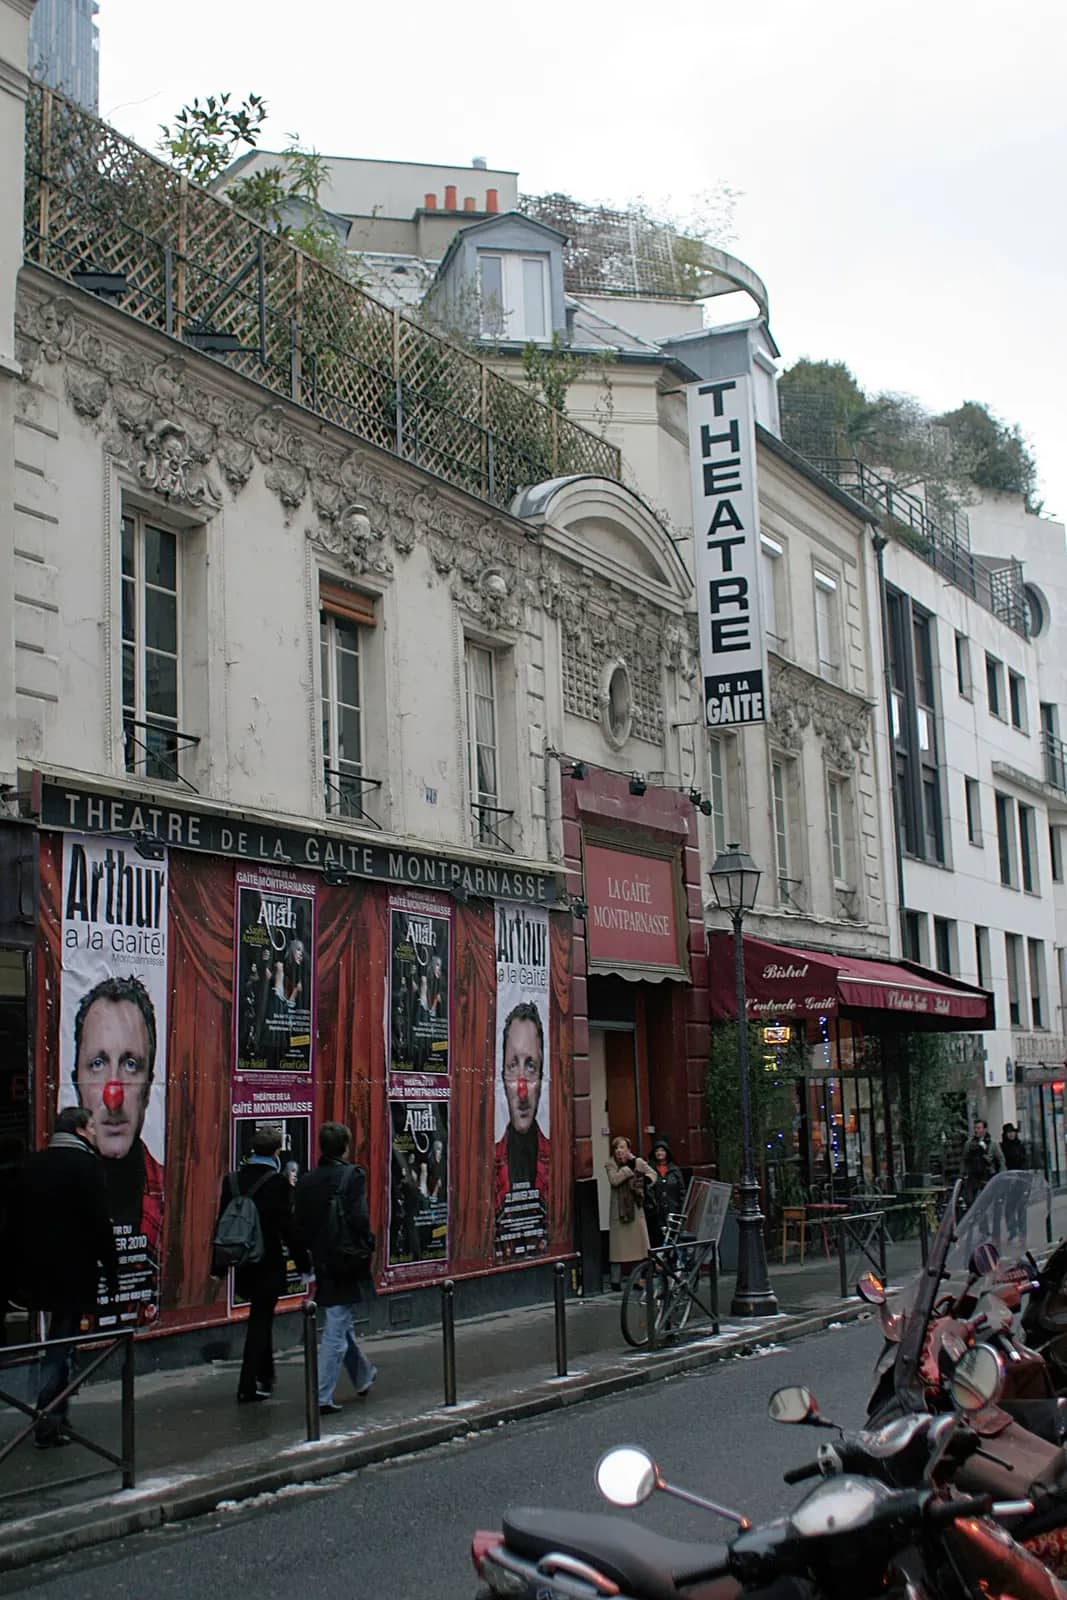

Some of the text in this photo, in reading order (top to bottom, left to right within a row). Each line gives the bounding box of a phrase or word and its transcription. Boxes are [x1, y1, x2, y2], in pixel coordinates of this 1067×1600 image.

[698, 380, 751, 654] THEATRE
[718, 680, 749, 693] DE LA
[707, 692, 763, 724] GAITE
[65, 793, 546, 900] THEATRE DE LA GAITE MONTPARNASSE
[66, 843, 165, 929] Arthur
[608, 876, 621, 900] LA
[593, 905, 671, 936] MONTPARNASSE
[66, 929, 78, 950] a
[86, 924, 104, 951] la
[497, 907, 548, 968] Arthur
[507, 965, 517, 983] la
[253, 1102, 312, 1113] MONTPARNASSE
[128, 1235, 147, 1250] 2010
